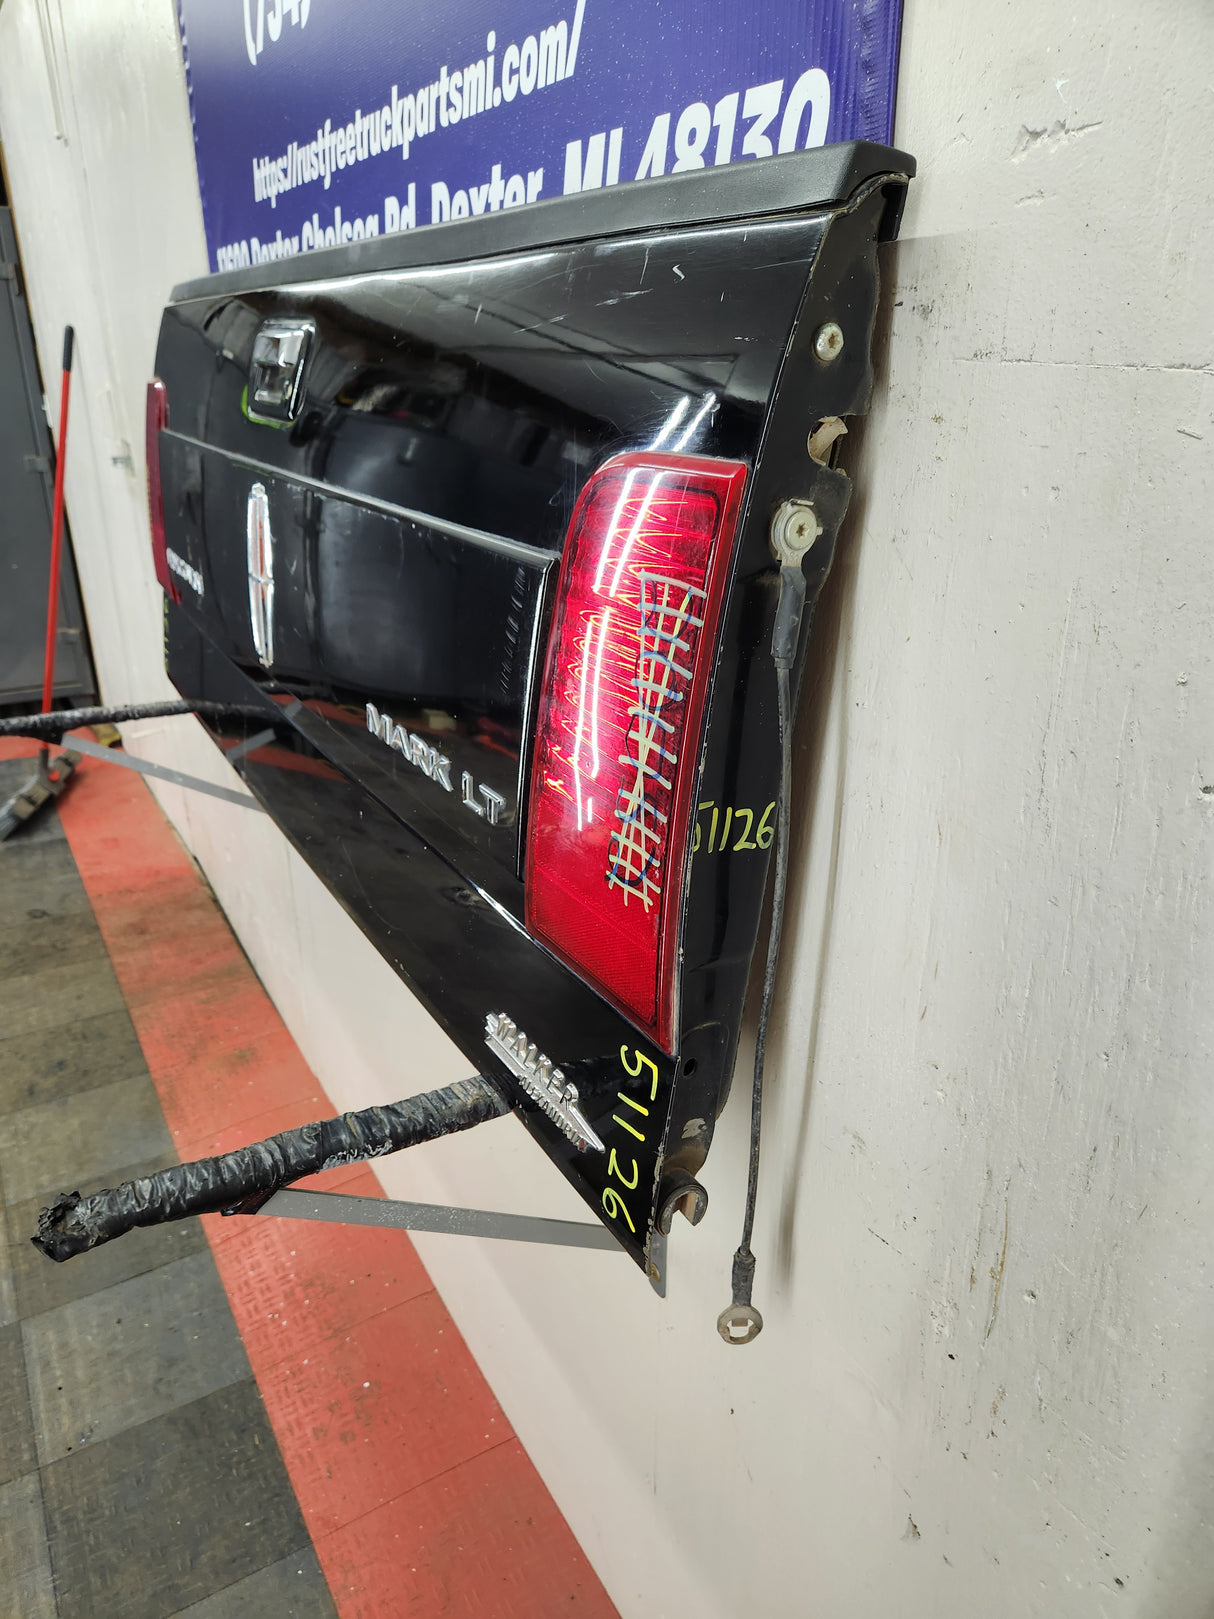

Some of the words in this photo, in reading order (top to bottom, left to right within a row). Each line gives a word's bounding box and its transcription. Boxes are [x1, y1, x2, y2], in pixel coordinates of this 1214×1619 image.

[635, 67, 831, 181] 48130
[366, 702, 454, 792] MARK
[461, 770, 505, 826] LT
[693, 801, 776, 854] 51126
[602, 1044, 658, 1234] 51126
